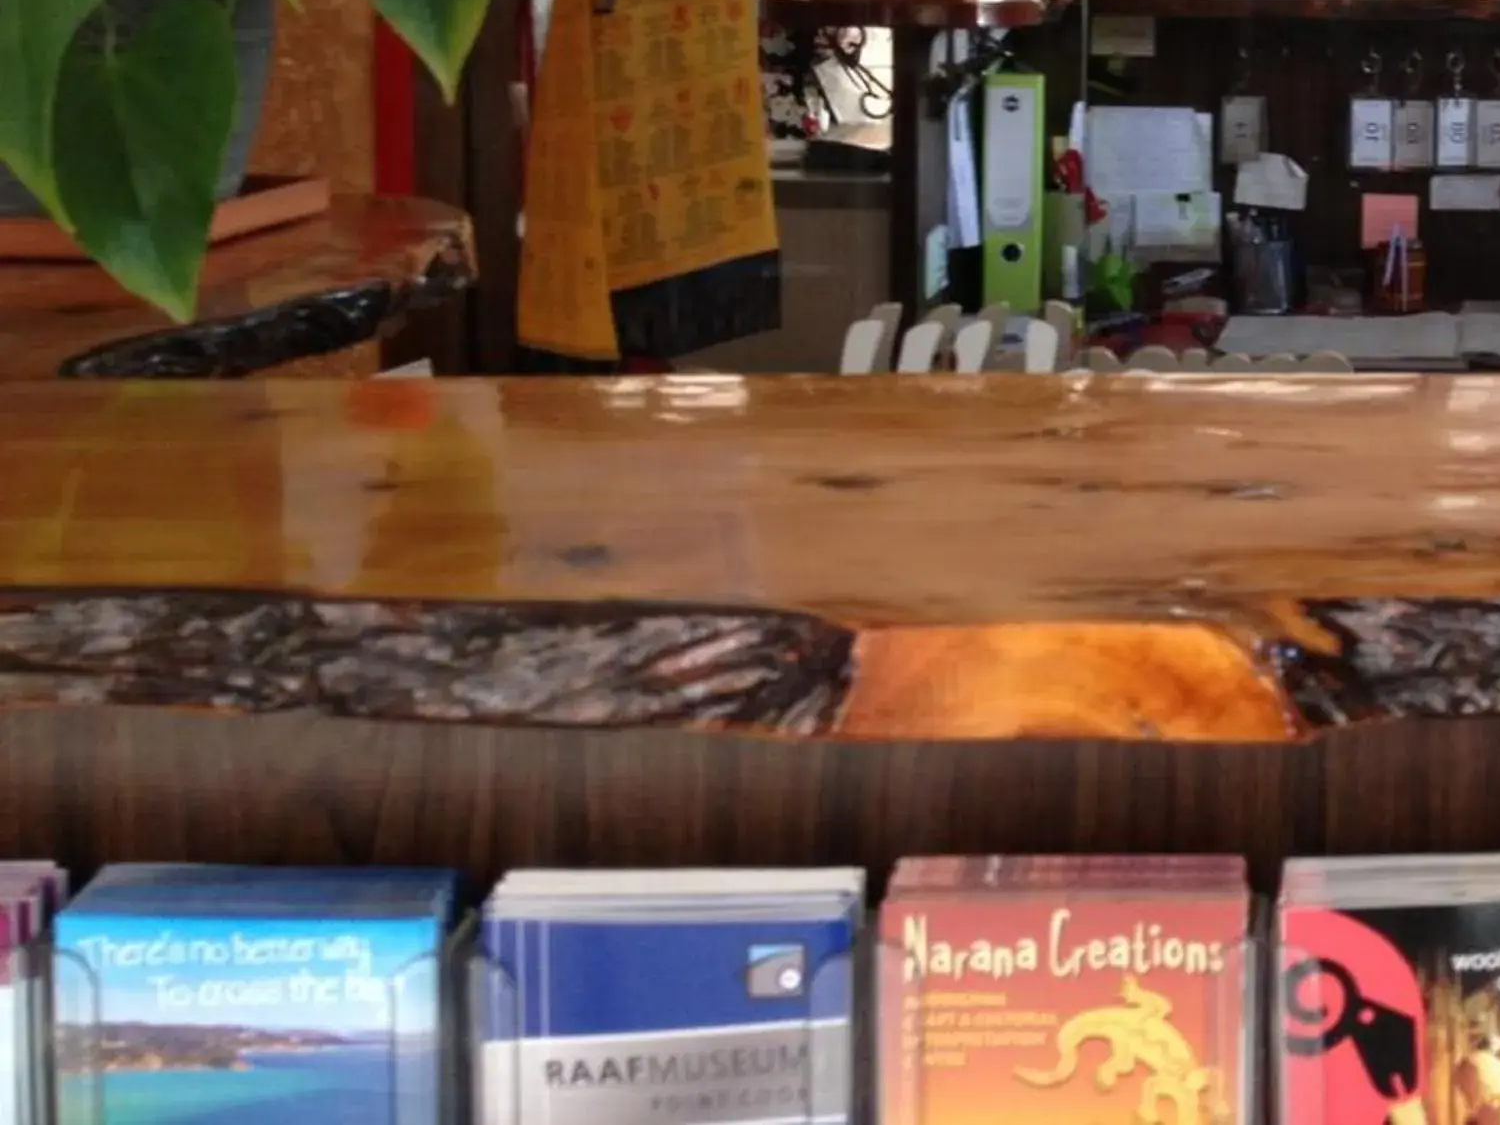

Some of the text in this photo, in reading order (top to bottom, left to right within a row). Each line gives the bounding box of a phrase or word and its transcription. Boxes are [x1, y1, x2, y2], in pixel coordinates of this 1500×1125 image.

[190, 939, 231, 966] no
[903, 908, 1226, 982] Narana Creations
[288, 968, 338, 1004] the
